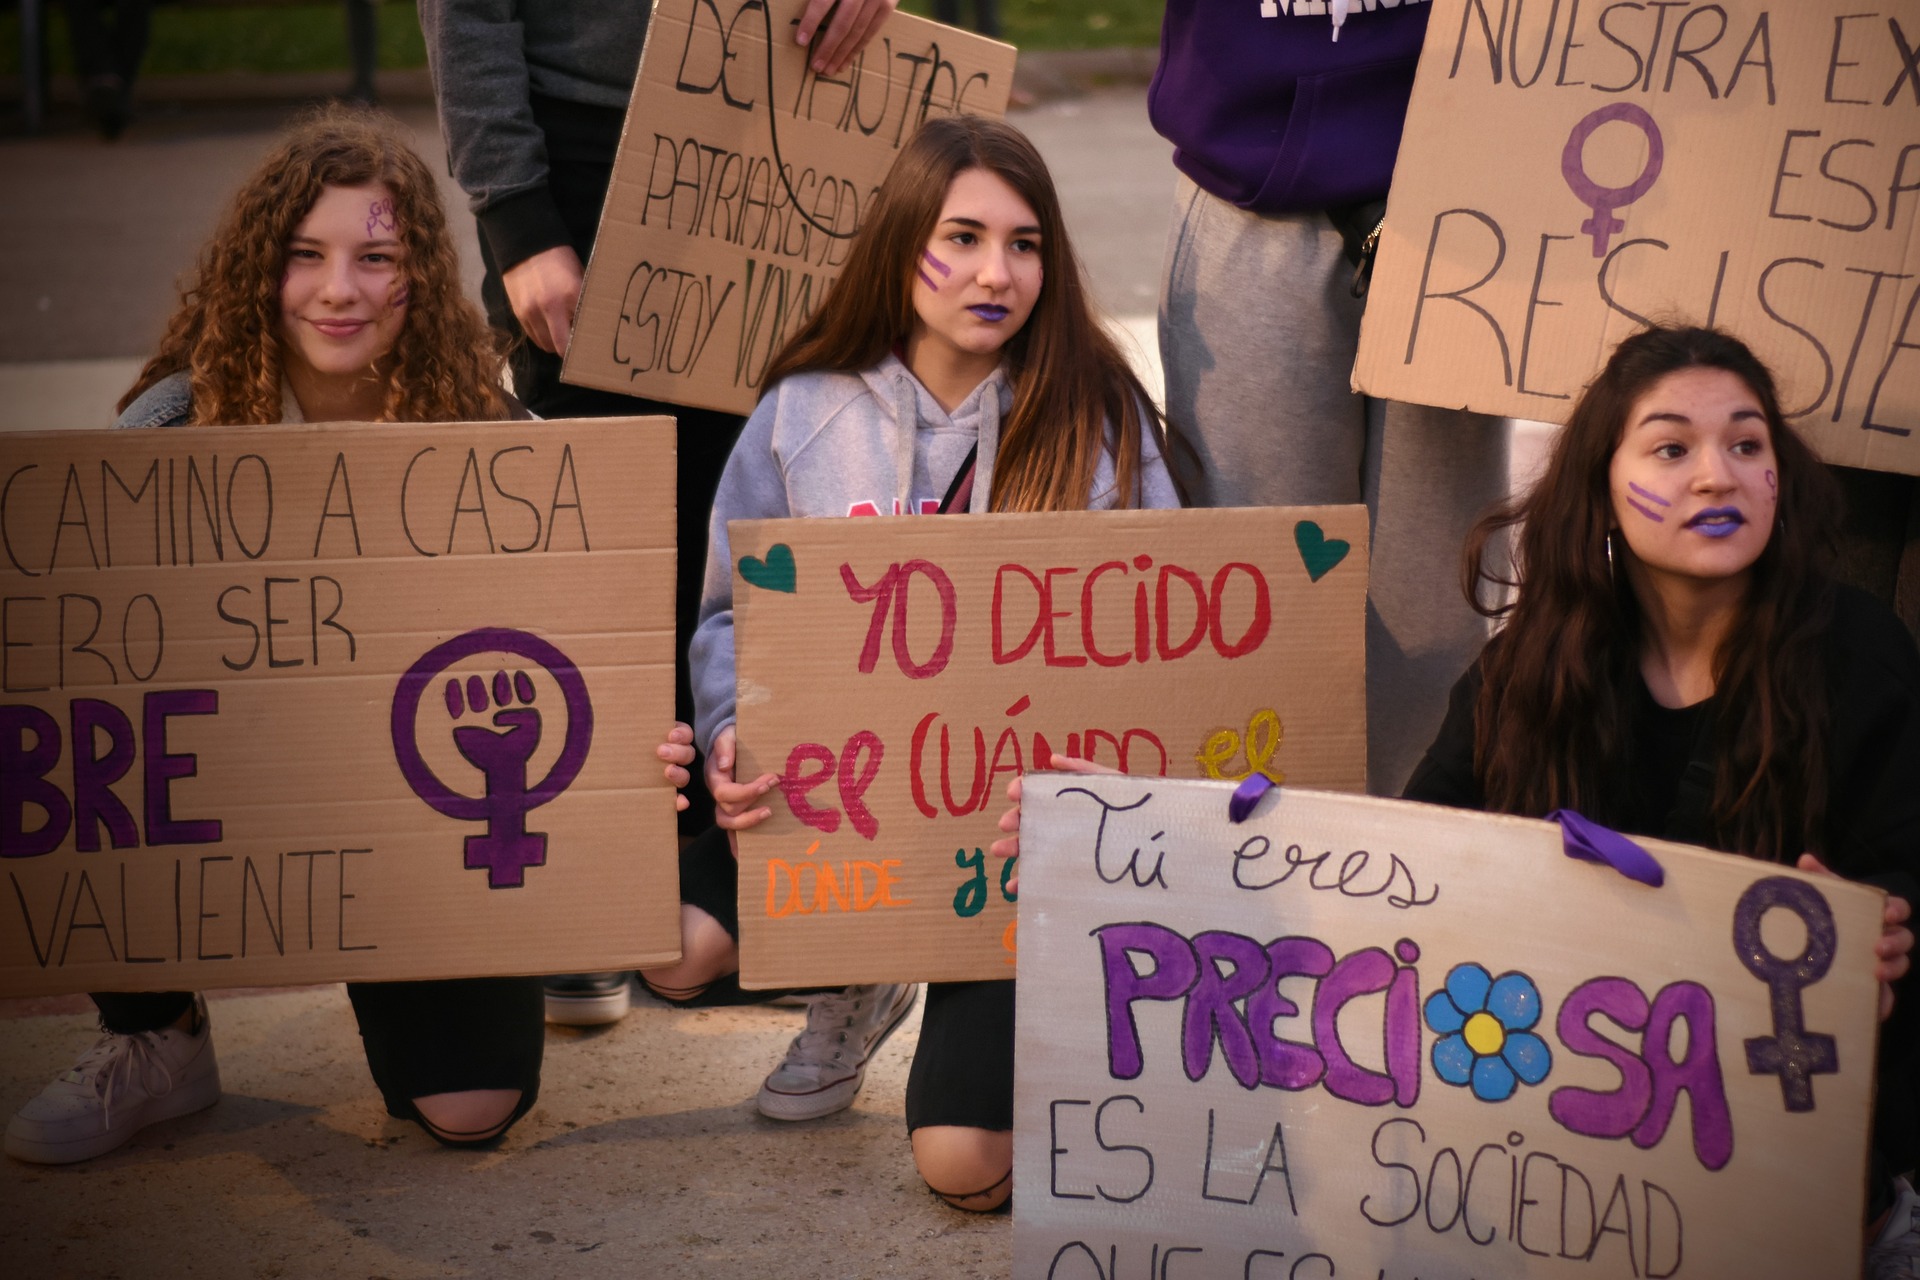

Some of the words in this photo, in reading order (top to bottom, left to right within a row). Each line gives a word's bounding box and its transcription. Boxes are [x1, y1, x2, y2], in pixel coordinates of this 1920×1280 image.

[676, 0, 763, 112] DE
[1448, 0, 1776, 106] NUESTRA
[612, 260, 737, 382] ESTOY
[2, 454, 273, 577] CAMINO
[313, 452, 362, 558] A
[401, 443, 590, 557] CASA
[2, 593, 164, 693] ERO
[217, 576, 356, 671] SER
[839, 558, 957, 680] YO
[0, 689, 223, 859] BRE
[778, 729, 885, 842] el
[1195, 707, 1287, 784] el
[10, 848, 378, 968] VALIENTE
[765, 839, 913, 919] DÓNDE
[1056, 786, 1169, 890] Tú
[1232, 835, 1440, 909] eres
[1050, 1094, 1155, 1204] ES
[1202, 1108, 1298, 1217] LA
